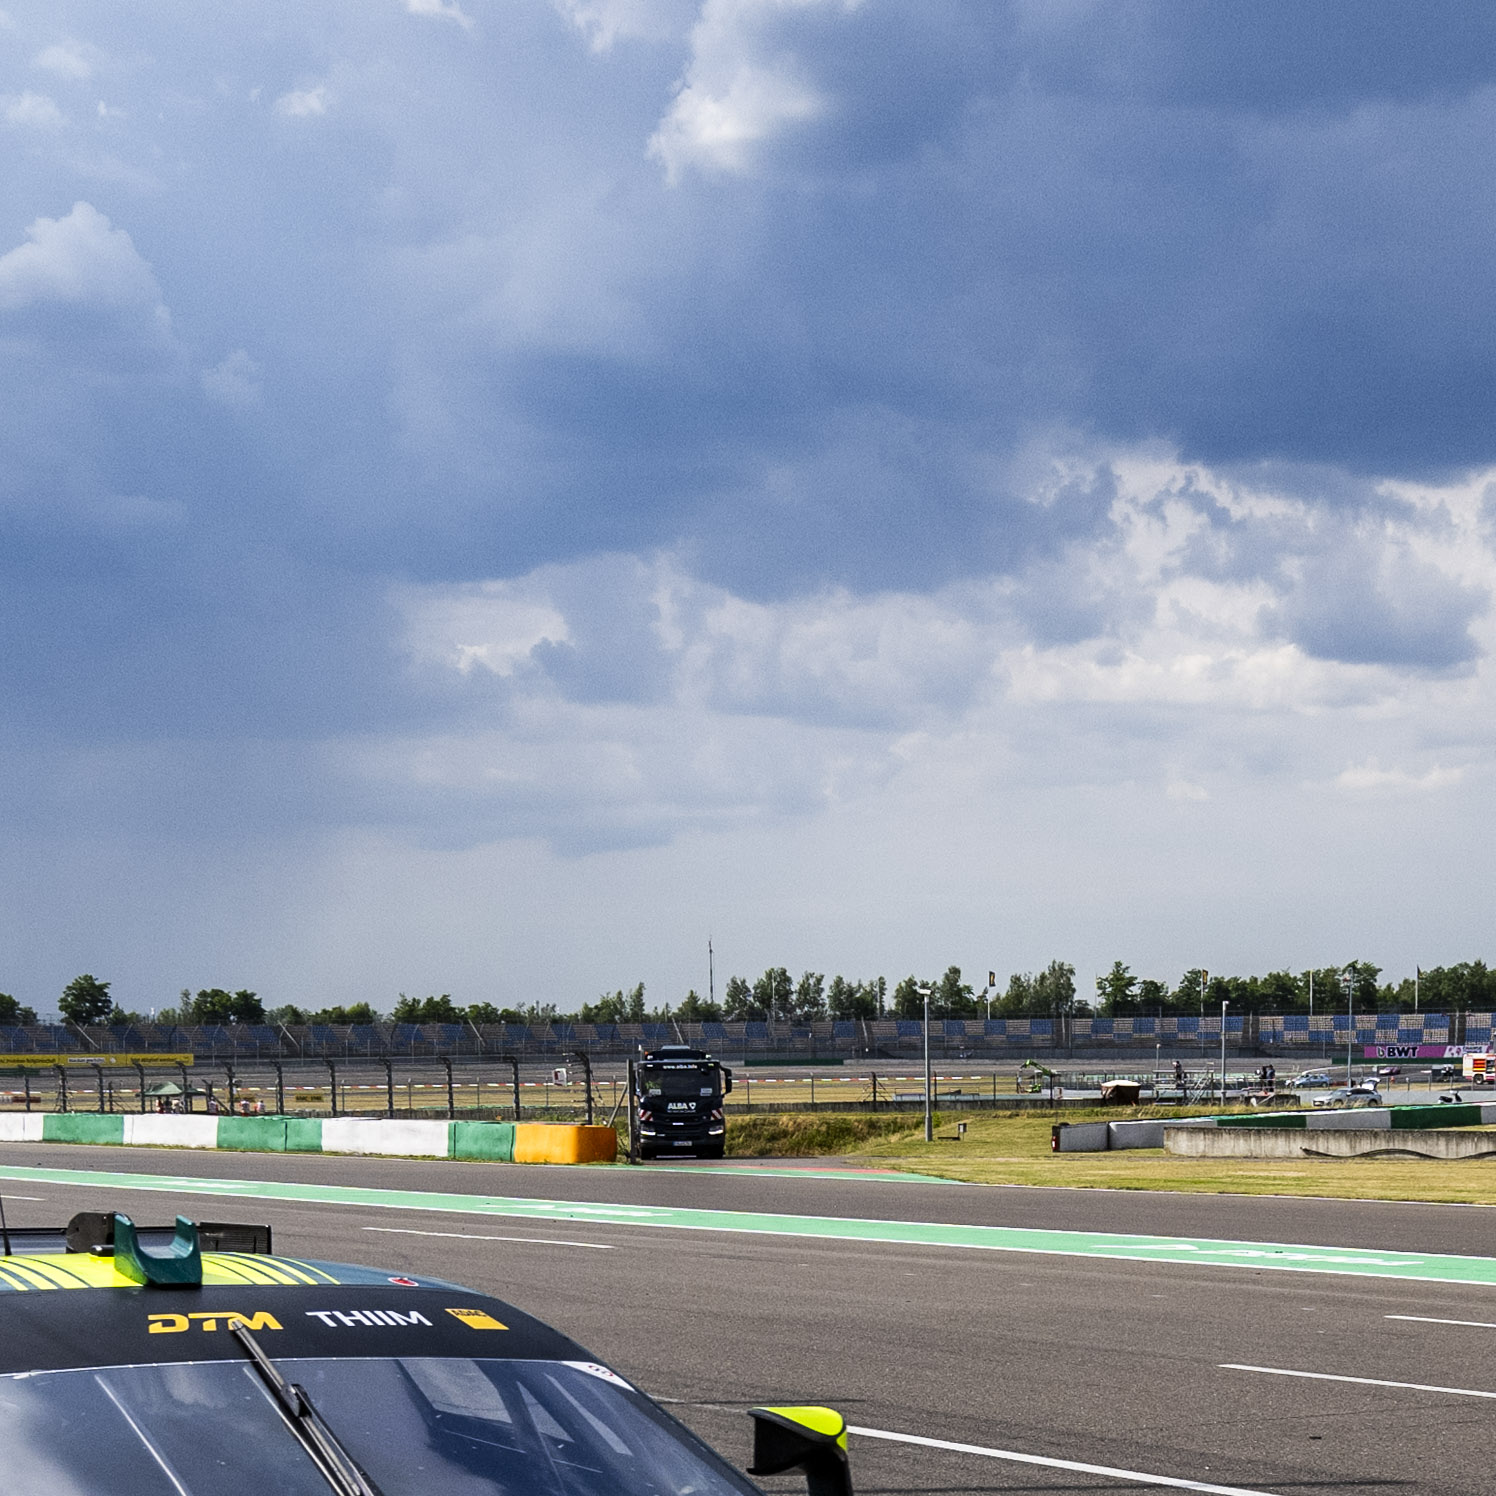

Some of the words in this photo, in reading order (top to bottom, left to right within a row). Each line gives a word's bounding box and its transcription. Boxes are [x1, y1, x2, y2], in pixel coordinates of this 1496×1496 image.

[1387, 1046, 1418, 1057] BWT
[147, 1312, 283, 1333] DTM
[305, 1310, 433, 1327] THIIM
